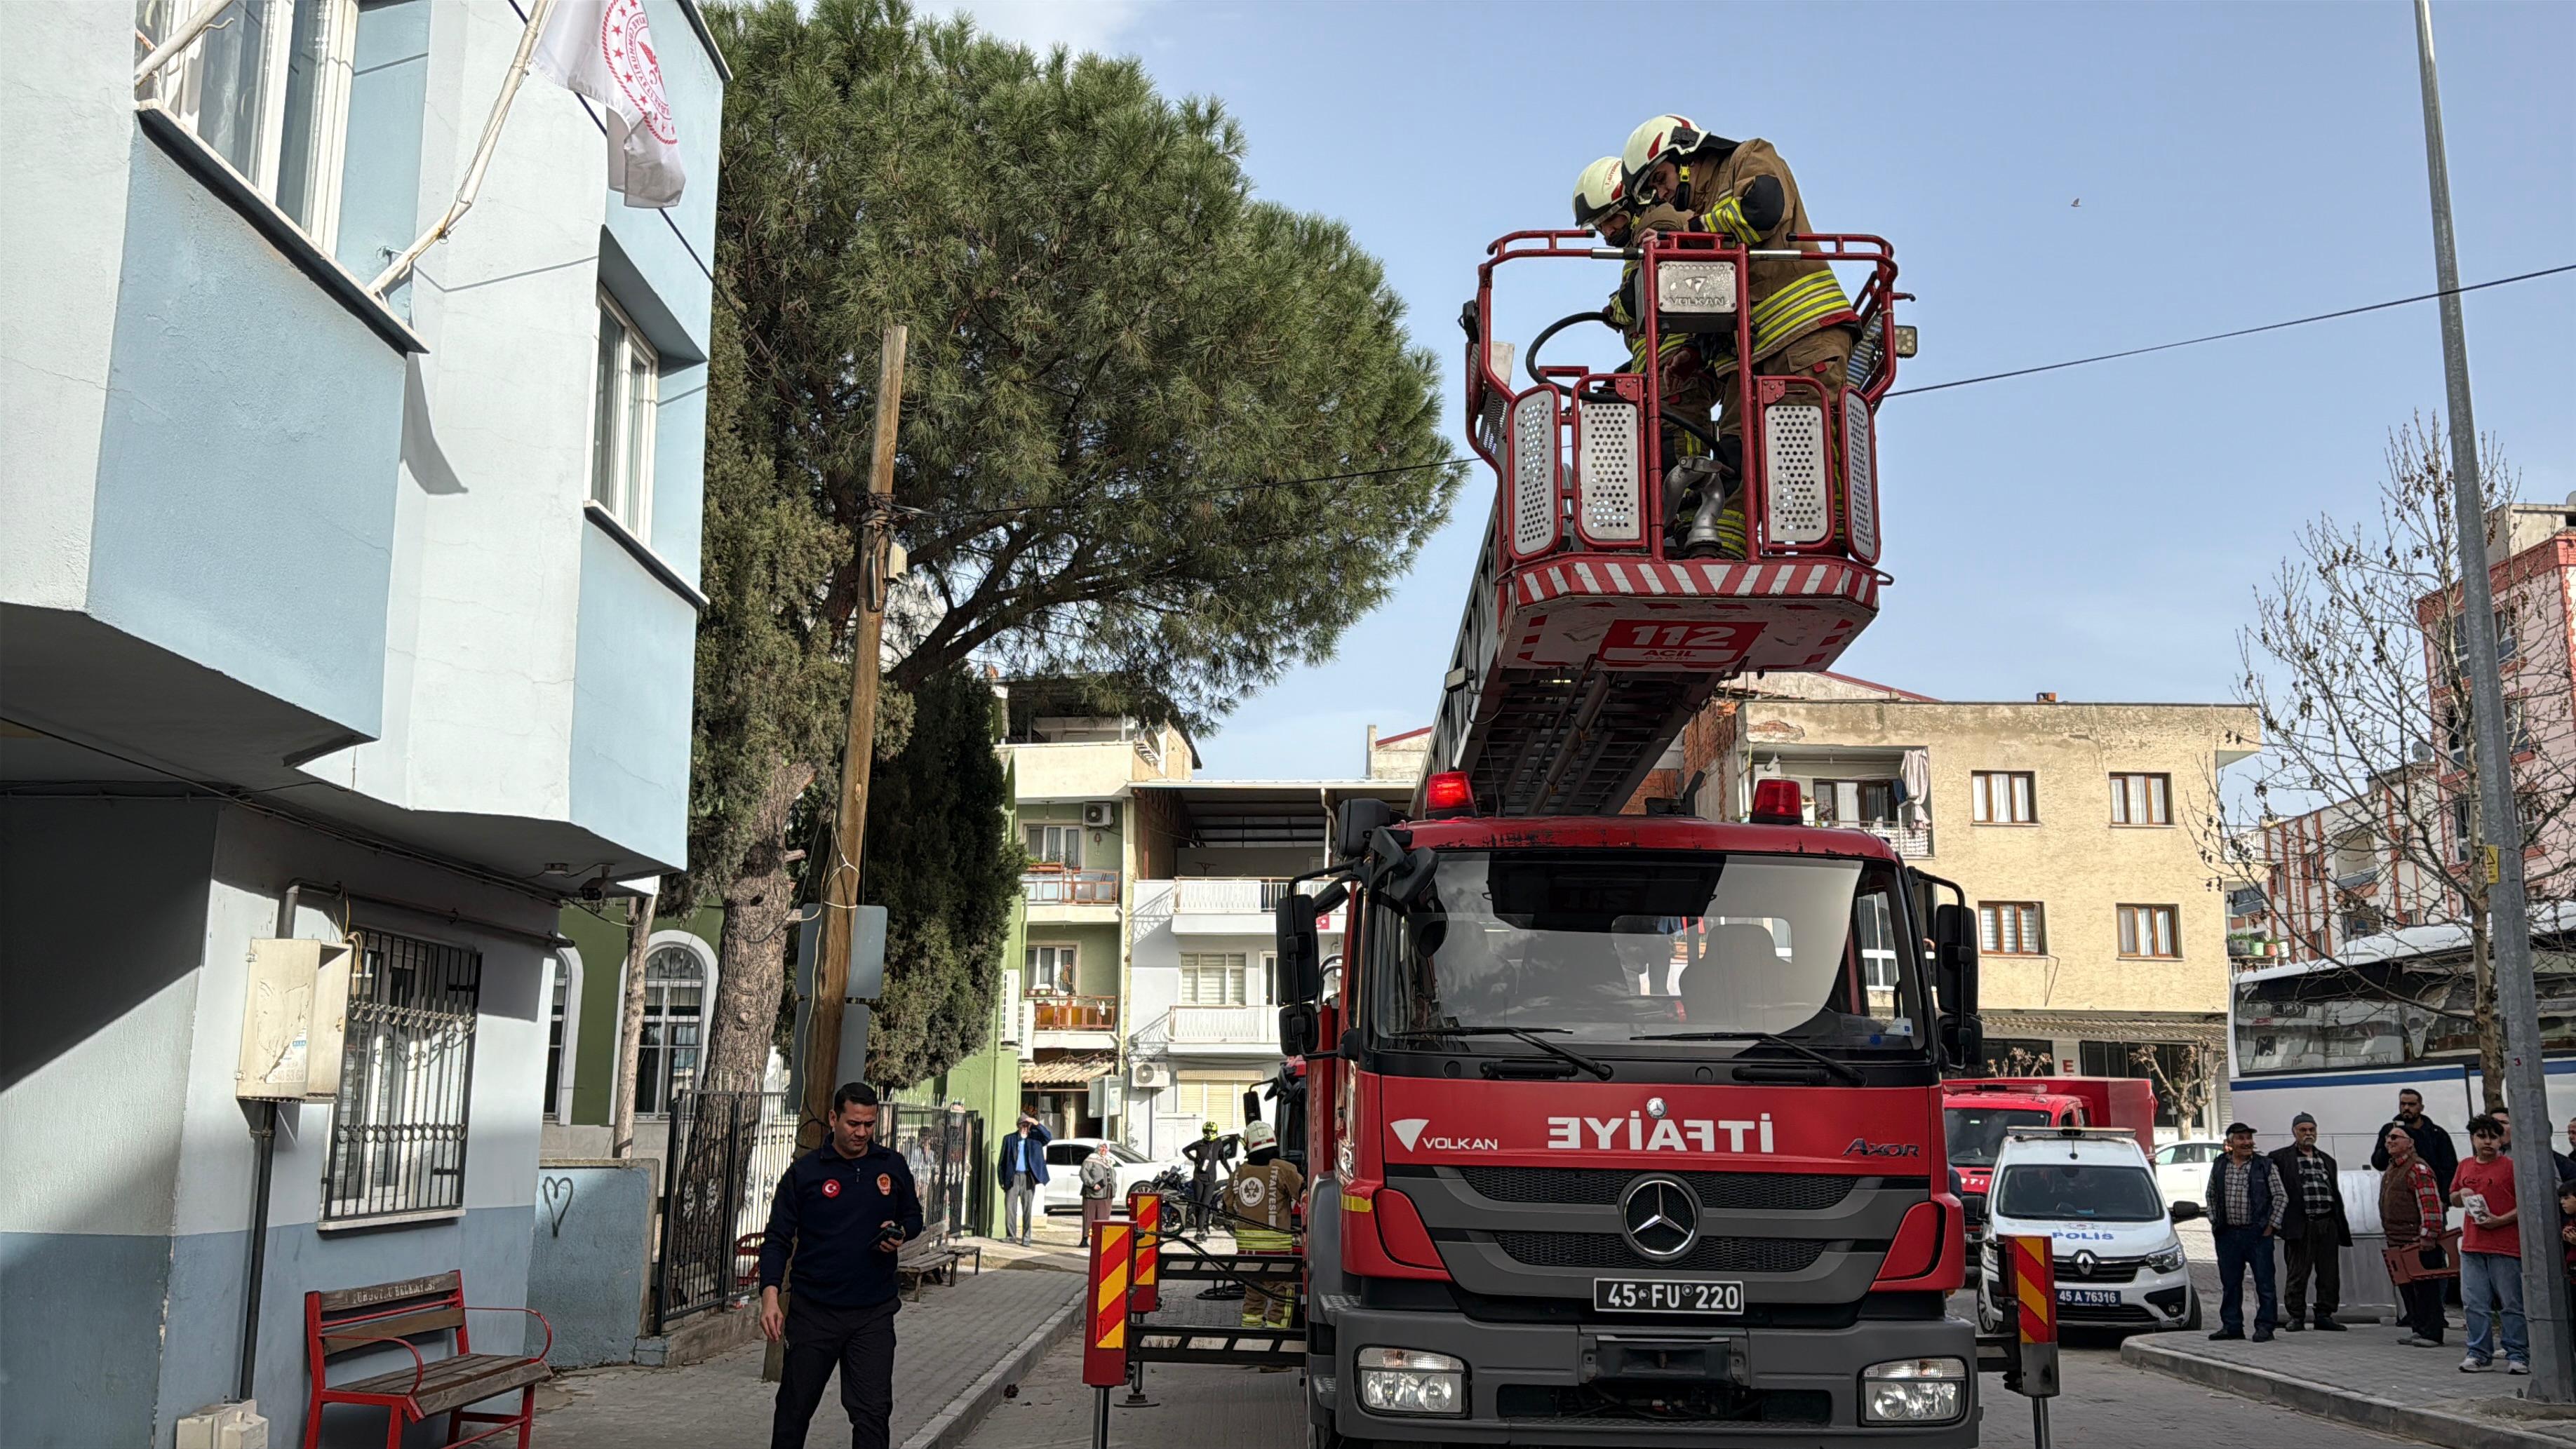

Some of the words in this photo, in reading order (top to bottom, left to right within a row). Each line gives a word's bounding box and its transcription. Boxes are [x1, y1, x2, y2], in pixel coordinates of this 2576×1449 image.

[1670, 297, 1726, 306] VOLKAN
[1632, 626, 1736, 647] 112
[1422, 1137, 1498, 1150] VOLKAN
[1608, 1283, 1636, 1307] 45
[1651, 1284, 1680, 1308] FU
[1695, 1286, 1739, 1309] 220
[2059, 1290, 2072, 1302] 45
[2074, 1291, 2082, 1302] A
[2084, 1291, 2117, 1304] 76316
